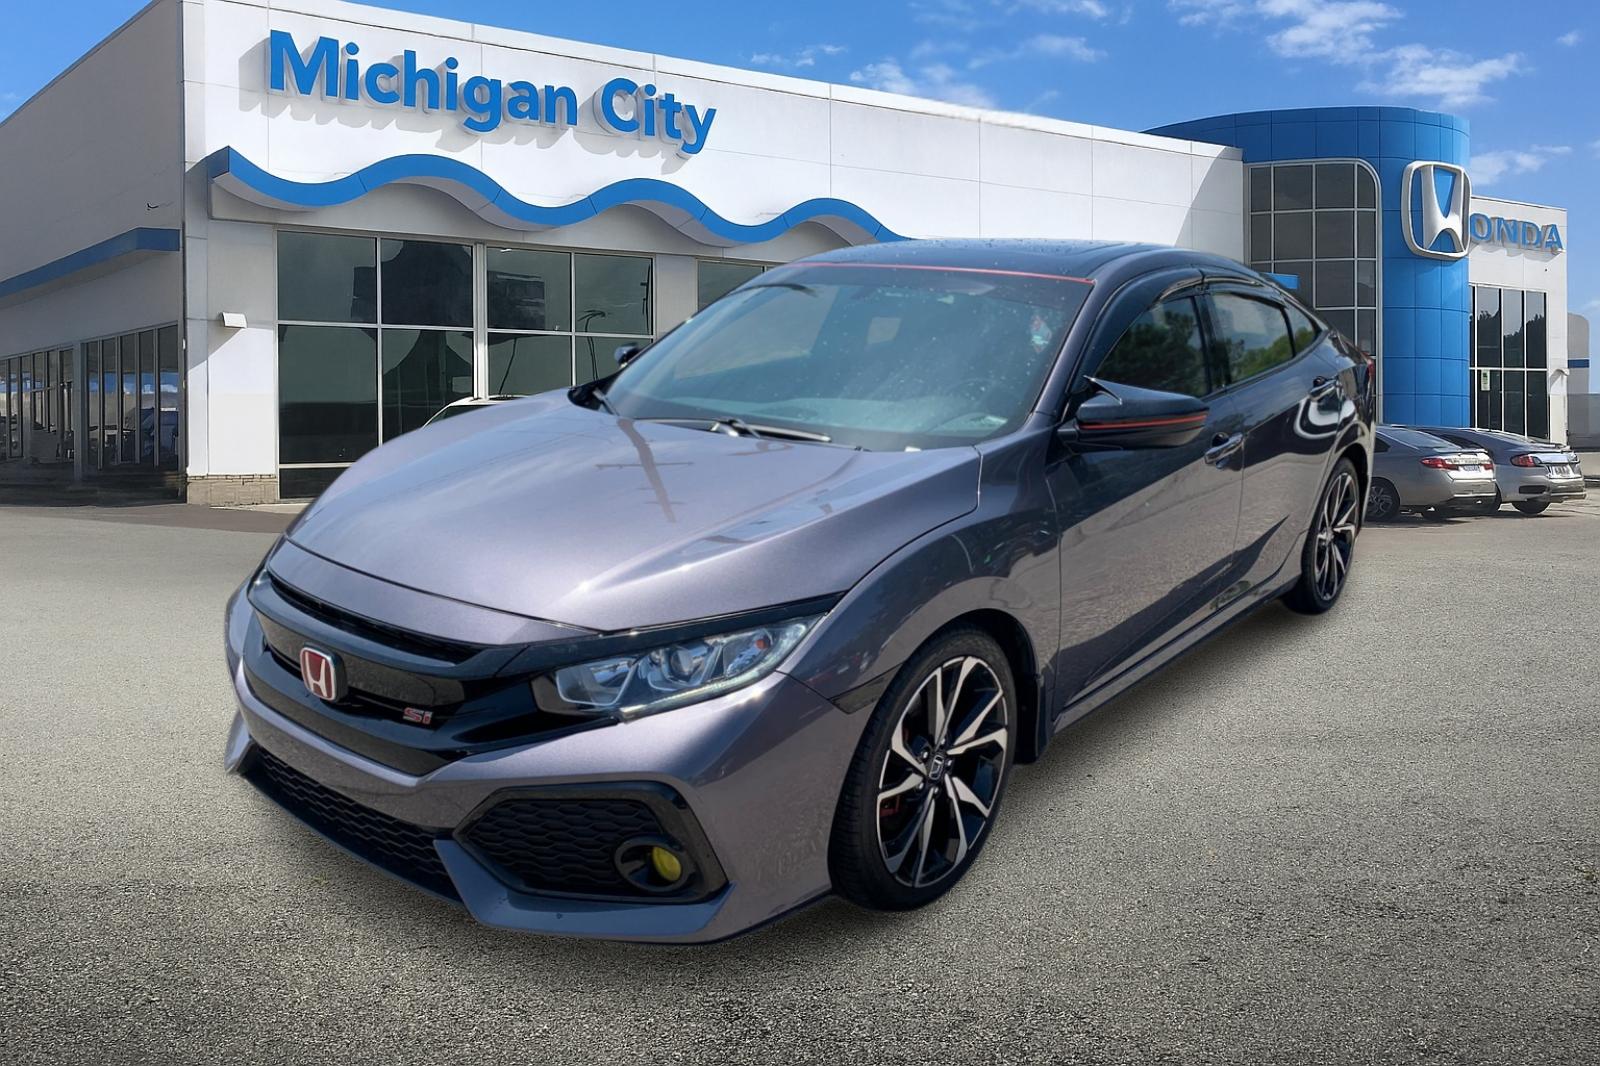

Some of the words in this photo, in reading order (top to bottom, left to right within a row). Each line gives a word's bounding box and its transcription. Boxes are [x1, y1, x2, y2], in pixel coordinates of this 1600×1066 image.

[270, 30, 578, 132] Michigan
[601, 78, 717, 154] City
[1469, 212, 1563, 250] ONDA
